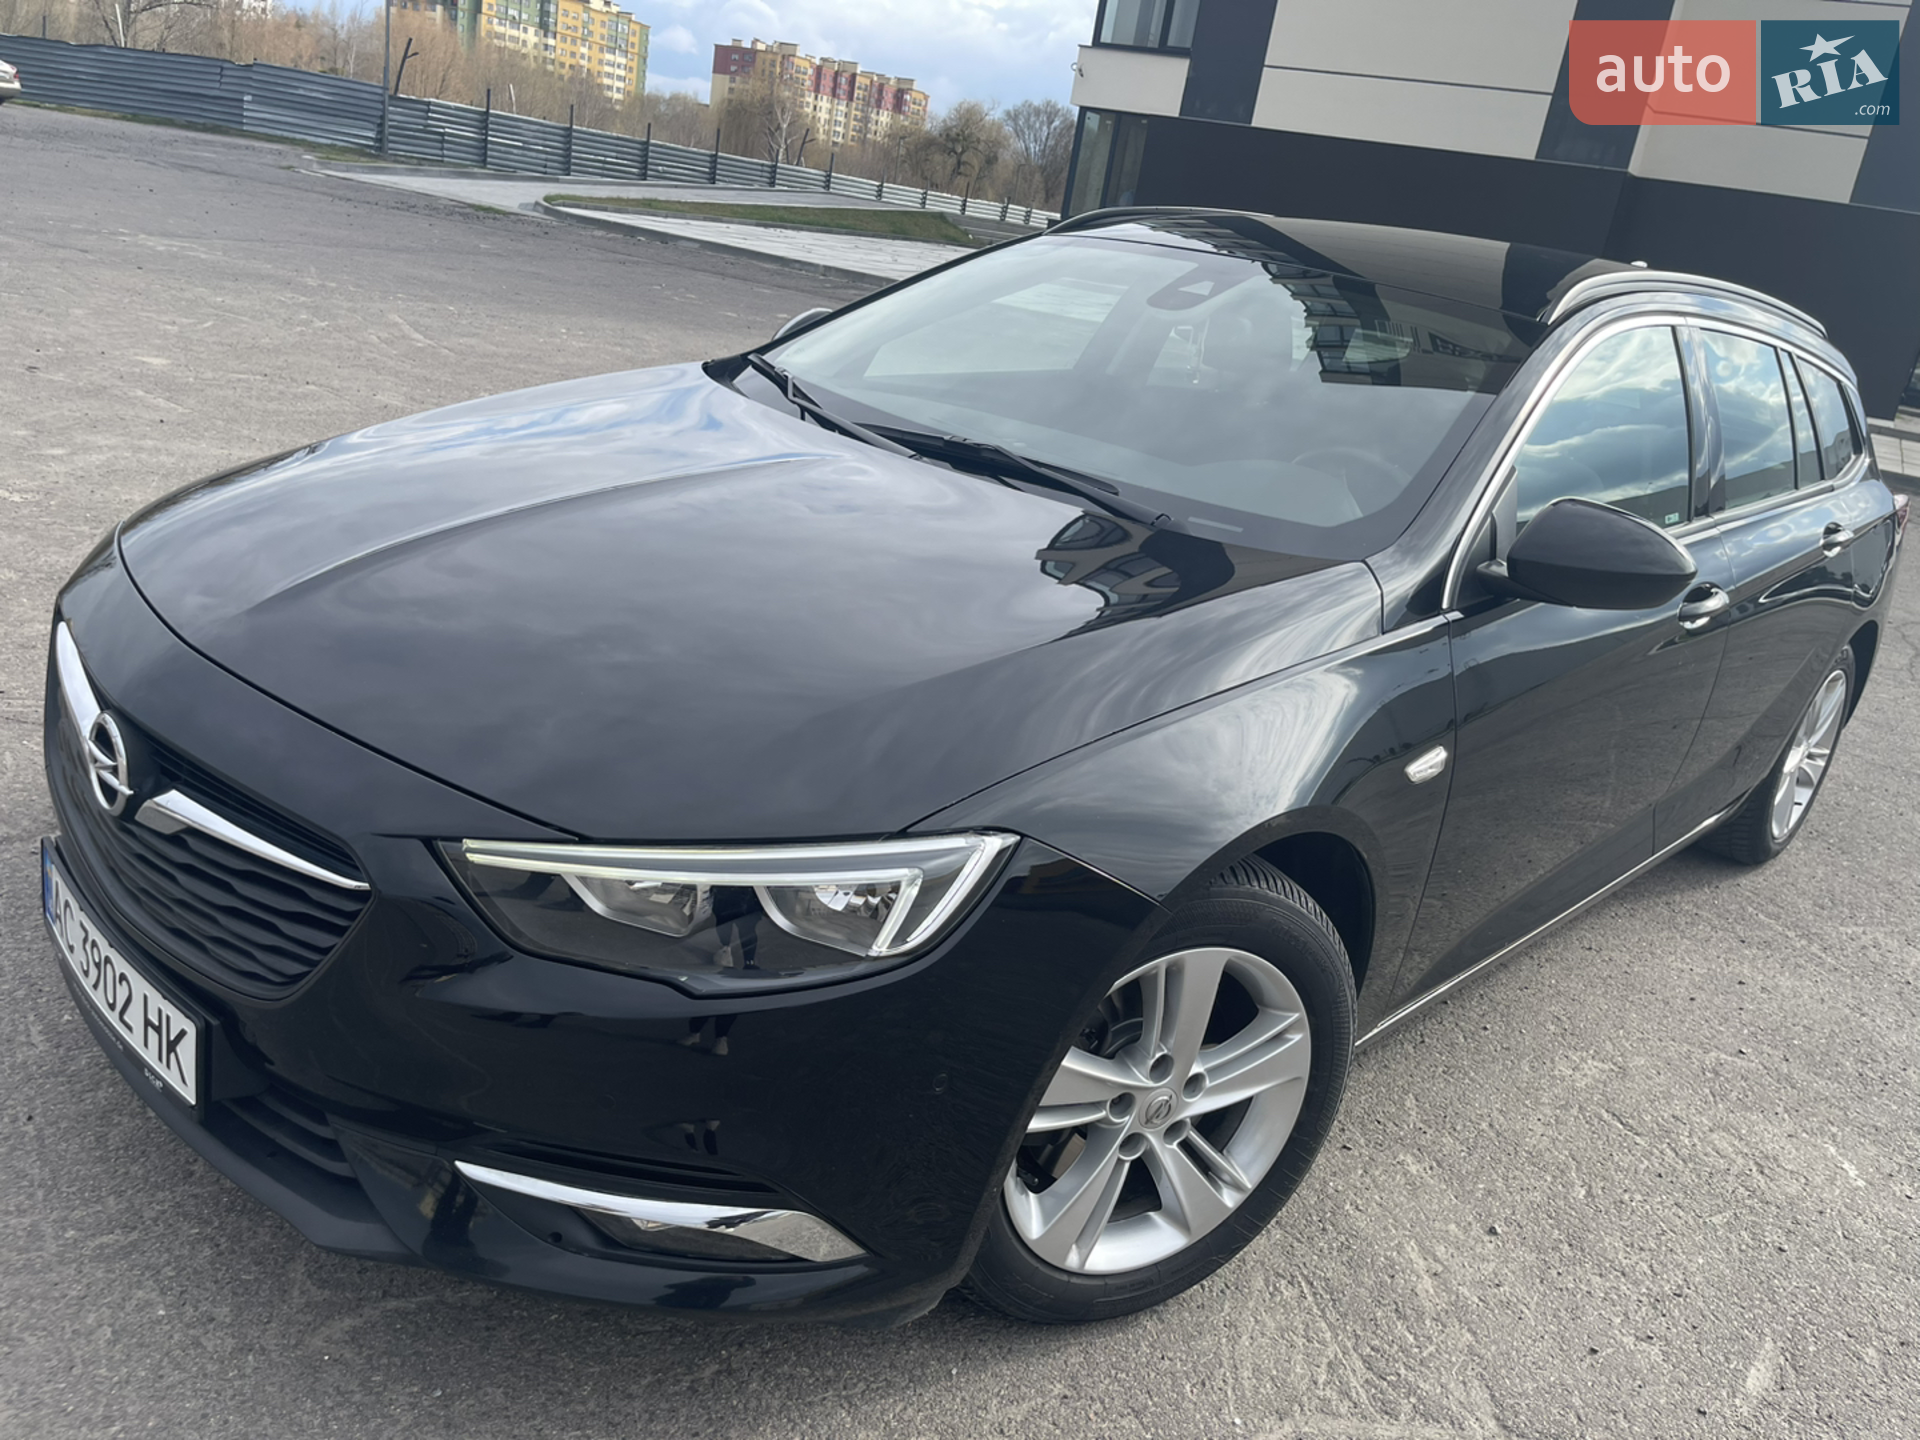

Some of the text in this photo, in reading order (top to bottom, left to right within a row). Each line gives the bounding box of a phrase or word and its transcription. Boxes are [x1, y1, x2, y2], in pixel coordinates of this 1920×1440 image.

[54, 880, 76, 954] AC
[79, 919, 134, 1034] 3902
[143, 991, 189, 1088] HK
